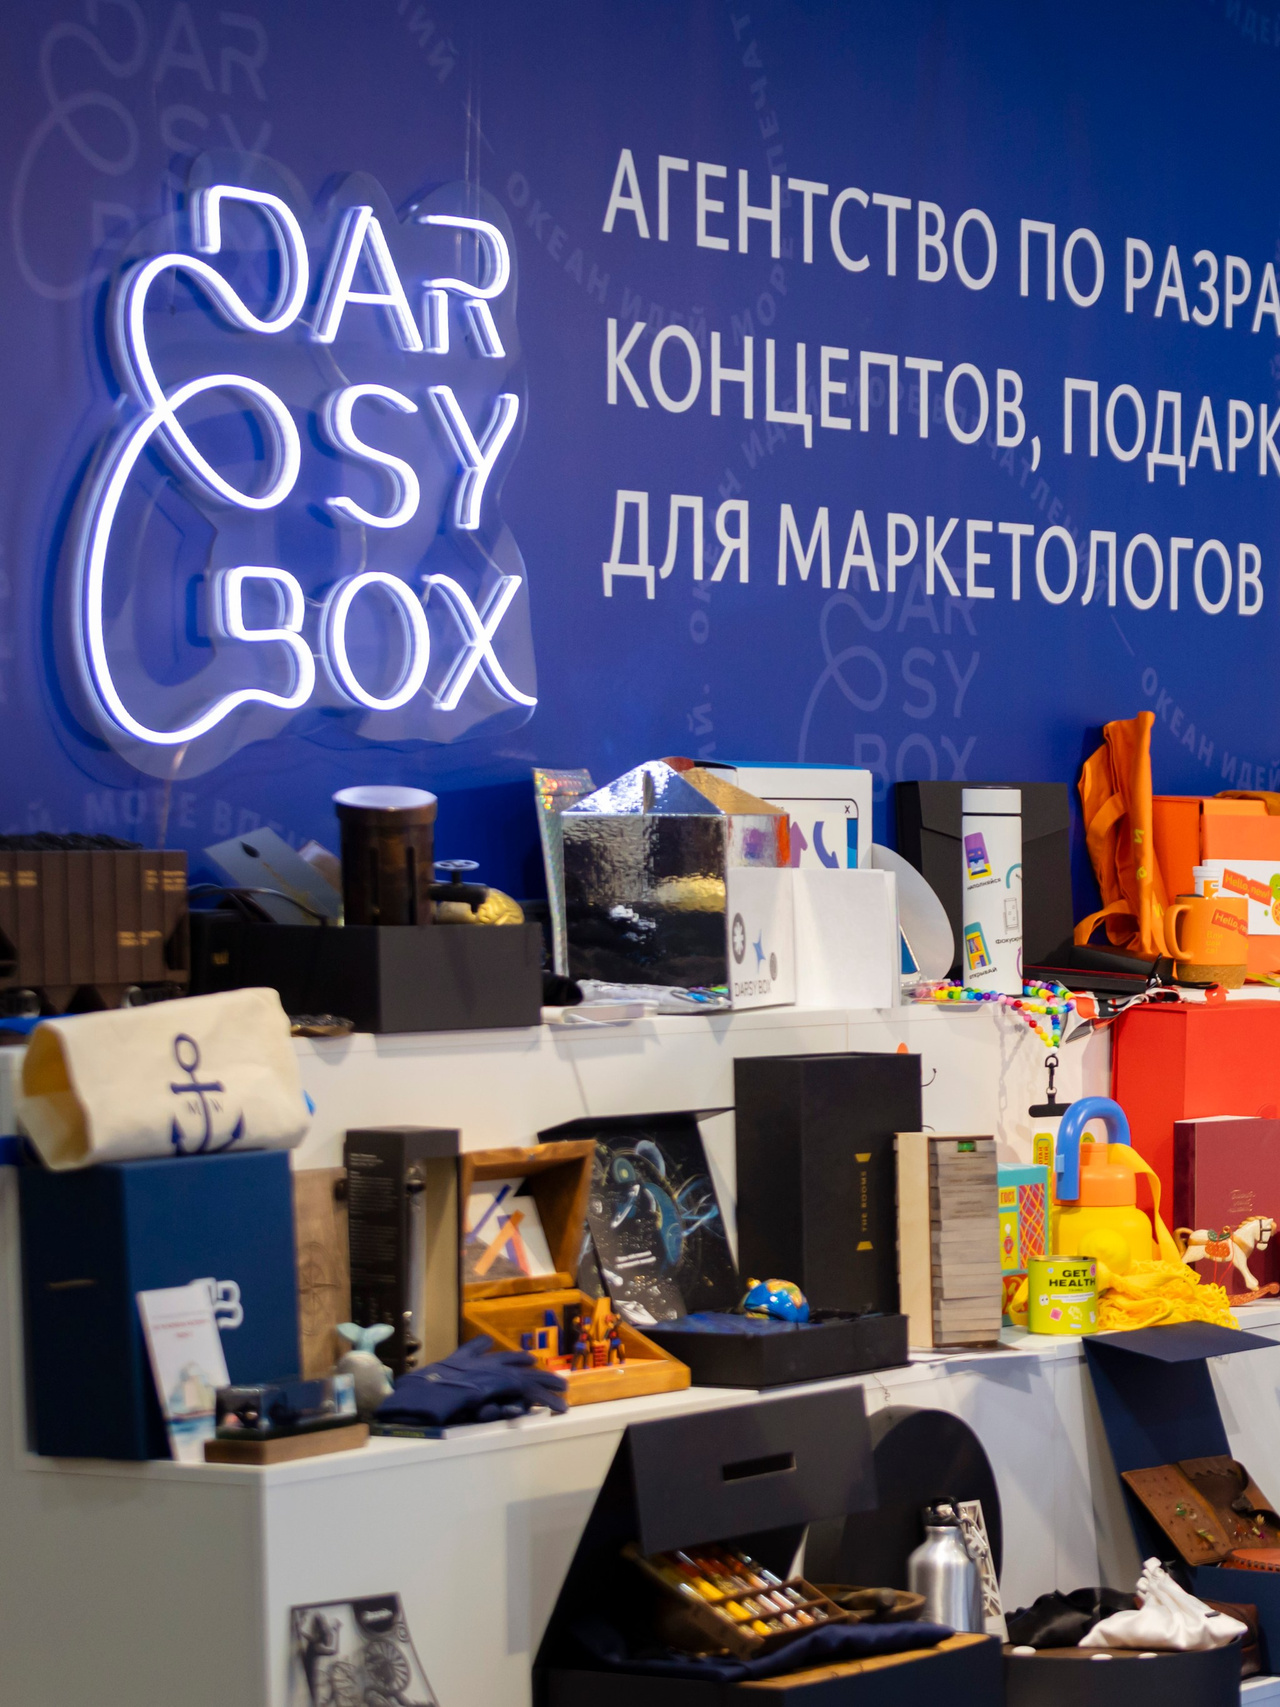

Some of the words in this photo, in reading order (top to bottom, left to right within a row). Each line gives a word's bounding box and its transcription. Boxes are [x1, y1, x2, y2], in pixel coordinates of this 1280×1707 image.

[602, 148, 998, 291] АГЕНТСТВО
[1020, 218, 1105, 308] ПО
[606, 317, 1042, 472] КОНЦЕПТОВ,
[602, 489, 749, 600] ДЛЯ
[777, 503, 1264, 616] МАРКЕТОЛОГОВ
[215, 566, 538, 712] BOX
[1049, 1278, 1096, 1287] HEALTH
[1062, 1269, 1088, 1278] GET
